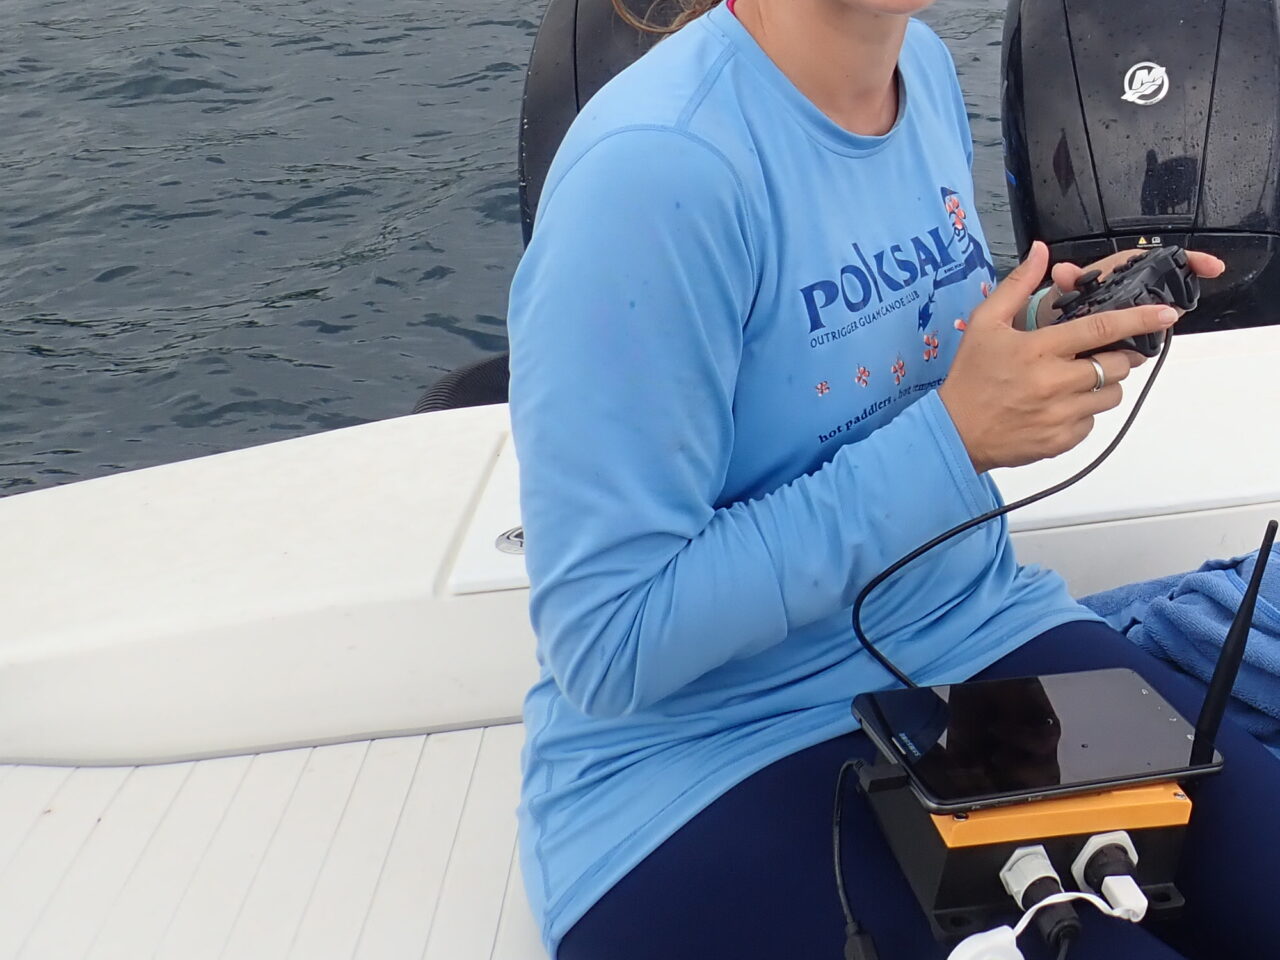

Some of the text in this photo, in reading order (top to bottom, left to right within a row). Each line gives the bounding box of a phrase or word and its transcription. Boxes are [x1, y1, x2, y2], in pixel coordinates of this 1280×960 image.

[810, 320, 859, 349] OUTRIGGER
[858, 308, 882, 327] GUAM
[880, 296, 906, 317] CANOE
[818, 425, 843, 444] hot
